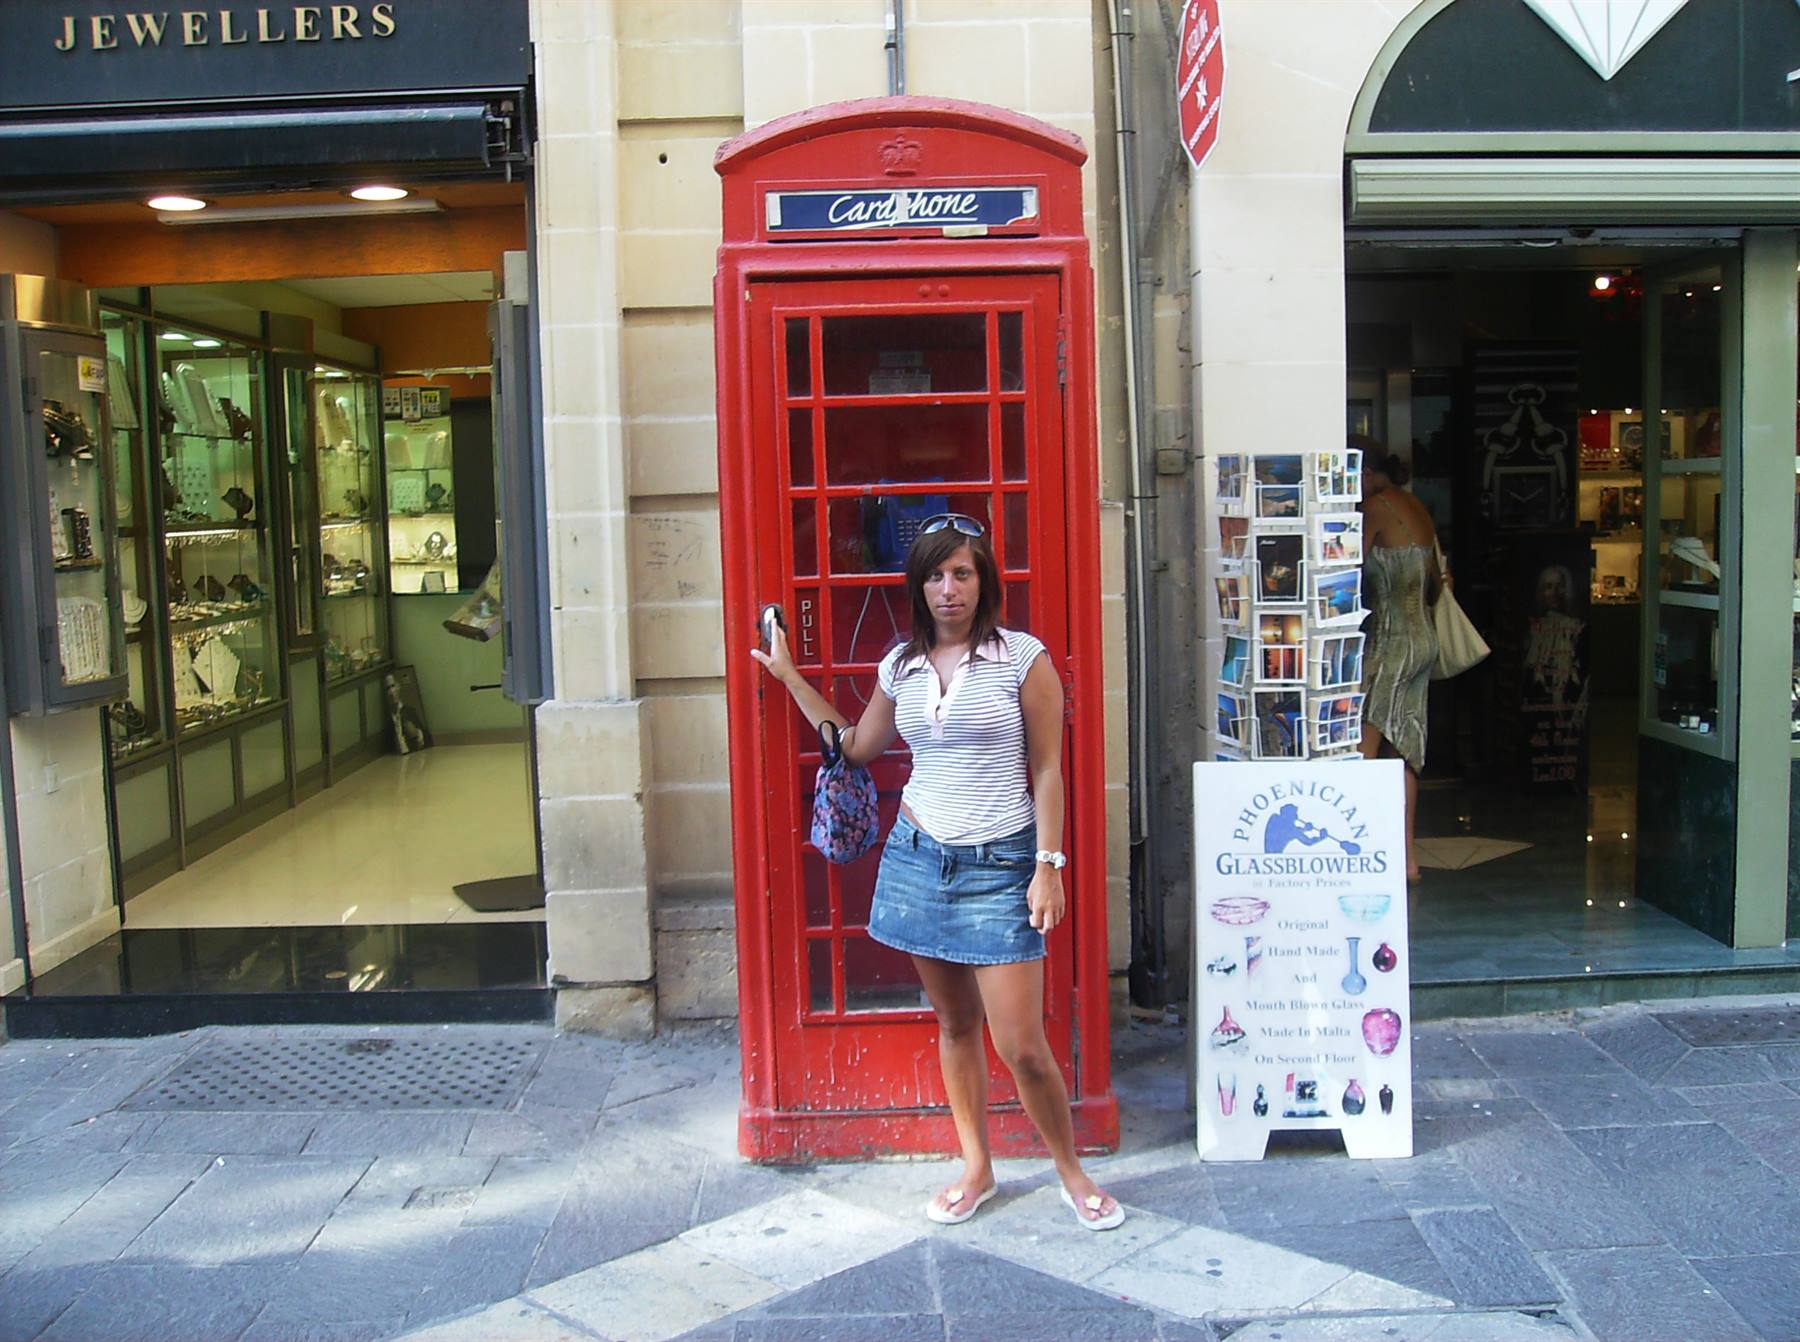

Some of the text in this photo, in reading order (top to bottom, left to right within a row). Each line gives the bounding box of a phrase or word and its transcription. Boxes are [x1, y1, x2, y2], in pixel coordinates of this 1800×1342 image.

[54, 3, 397, 51] JEWELLERS
[801, 599, 815, 656] PULL
[1233, 780, 1369, 841] PHOENICIAN
[1216, 850, 1388, 876] GLASSBLOWERS
[1268, 879, 1312, 890] Factory
[1315, 878, 1351, 888] Prices
[1277, 920, 1329, 932] Original
[1268, 946, 1340, 957] Hand Made
[1292, 974, 1318, 983] And
[1246, 999, 1365, 1010] Mouth Blown Glass
[1260, 1026, 1352, 1038] Made In Malta
[1255, 1054, 1357, 1065] On Second Floor
